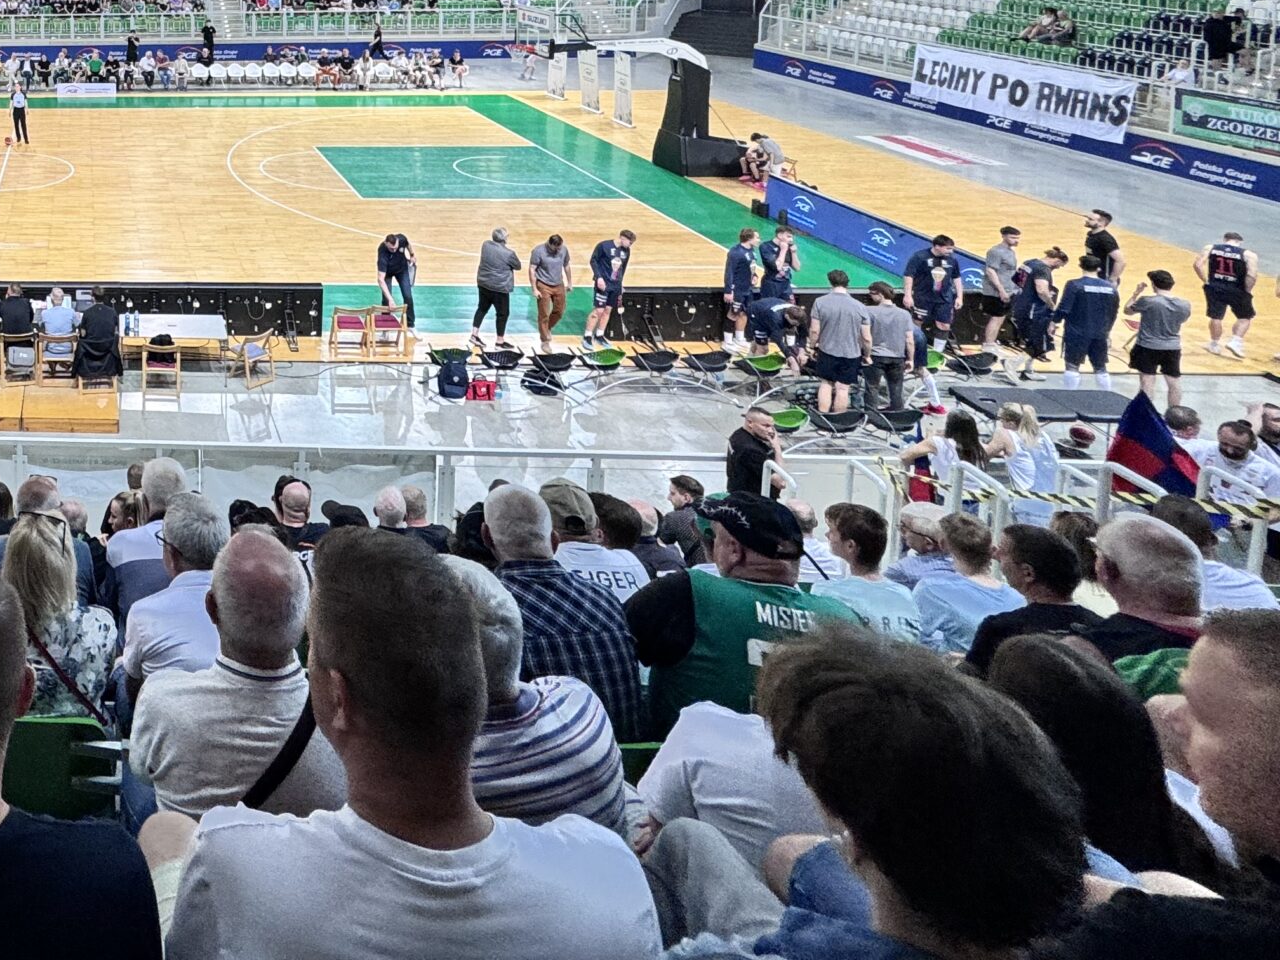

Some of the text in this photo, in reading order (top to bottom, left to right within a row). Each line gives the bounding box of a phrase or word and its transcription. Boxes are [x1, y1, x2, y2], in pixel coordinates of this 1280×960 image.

[527, 13, 547, 26] SUZUKI
[483, 48, 502, 56] PGE
[874, 87, 894, 100] PGE
[915, 58, 1132, 127] LECIMY PO AWANS
[986, 116, 1014, 130] PGE
[1130, 152, 1257, 182] PGE Polska Grupa
[1189, 168, 1253, 190] Energetyczna
[796, 201, 810, 212] PGE
[872, 234, 890, 247] PGE
